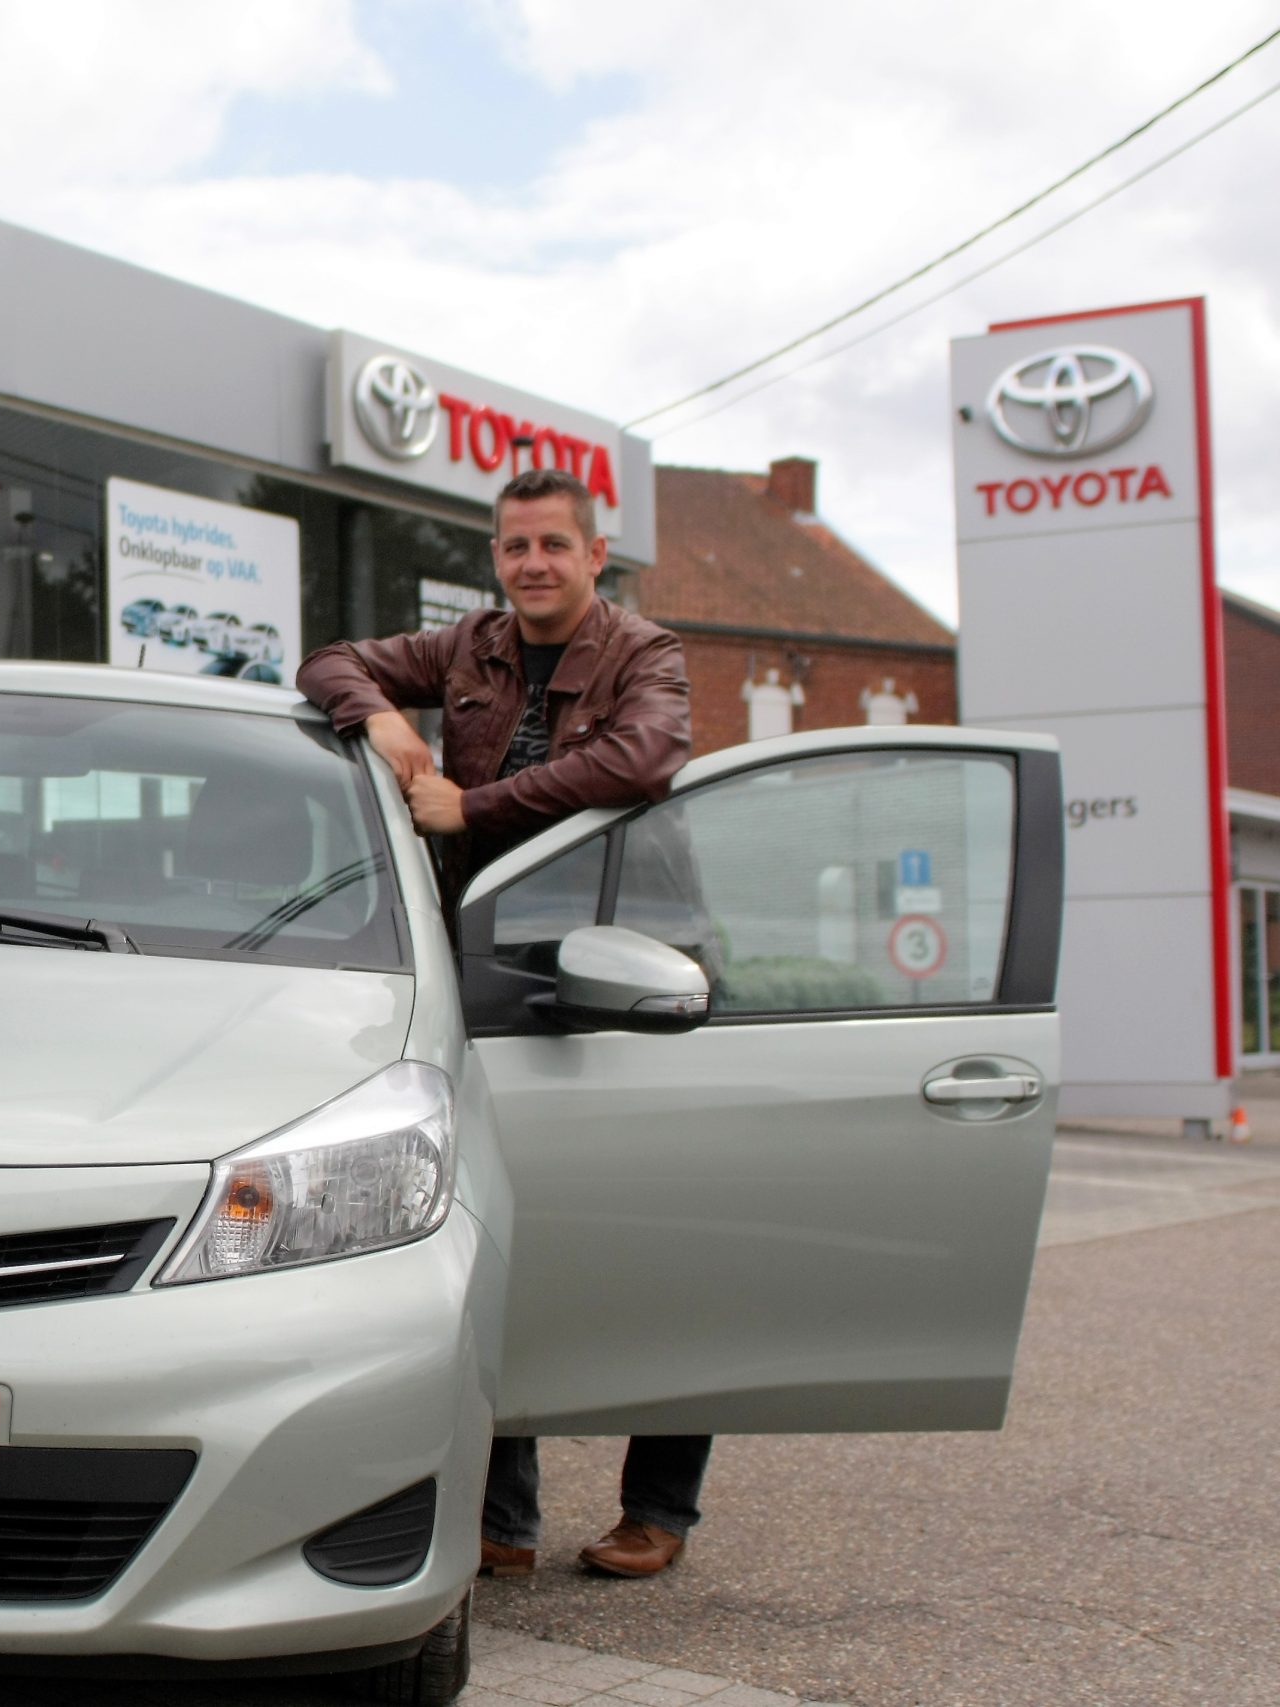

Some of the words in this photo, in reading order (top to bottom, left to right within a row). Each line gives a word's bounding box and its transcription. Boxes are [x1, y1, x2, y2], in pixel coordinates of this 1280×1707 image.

[439, 392, 618, 508] TOYOTA
[976, 464, 1173, 518] TOYOTA
[119, 503, 169, 535] Toyota
[119, 535, 203, 571] Onklopbaar
[207, 557, 225, 582] op
[1064, 795, 1137, 829] gers
